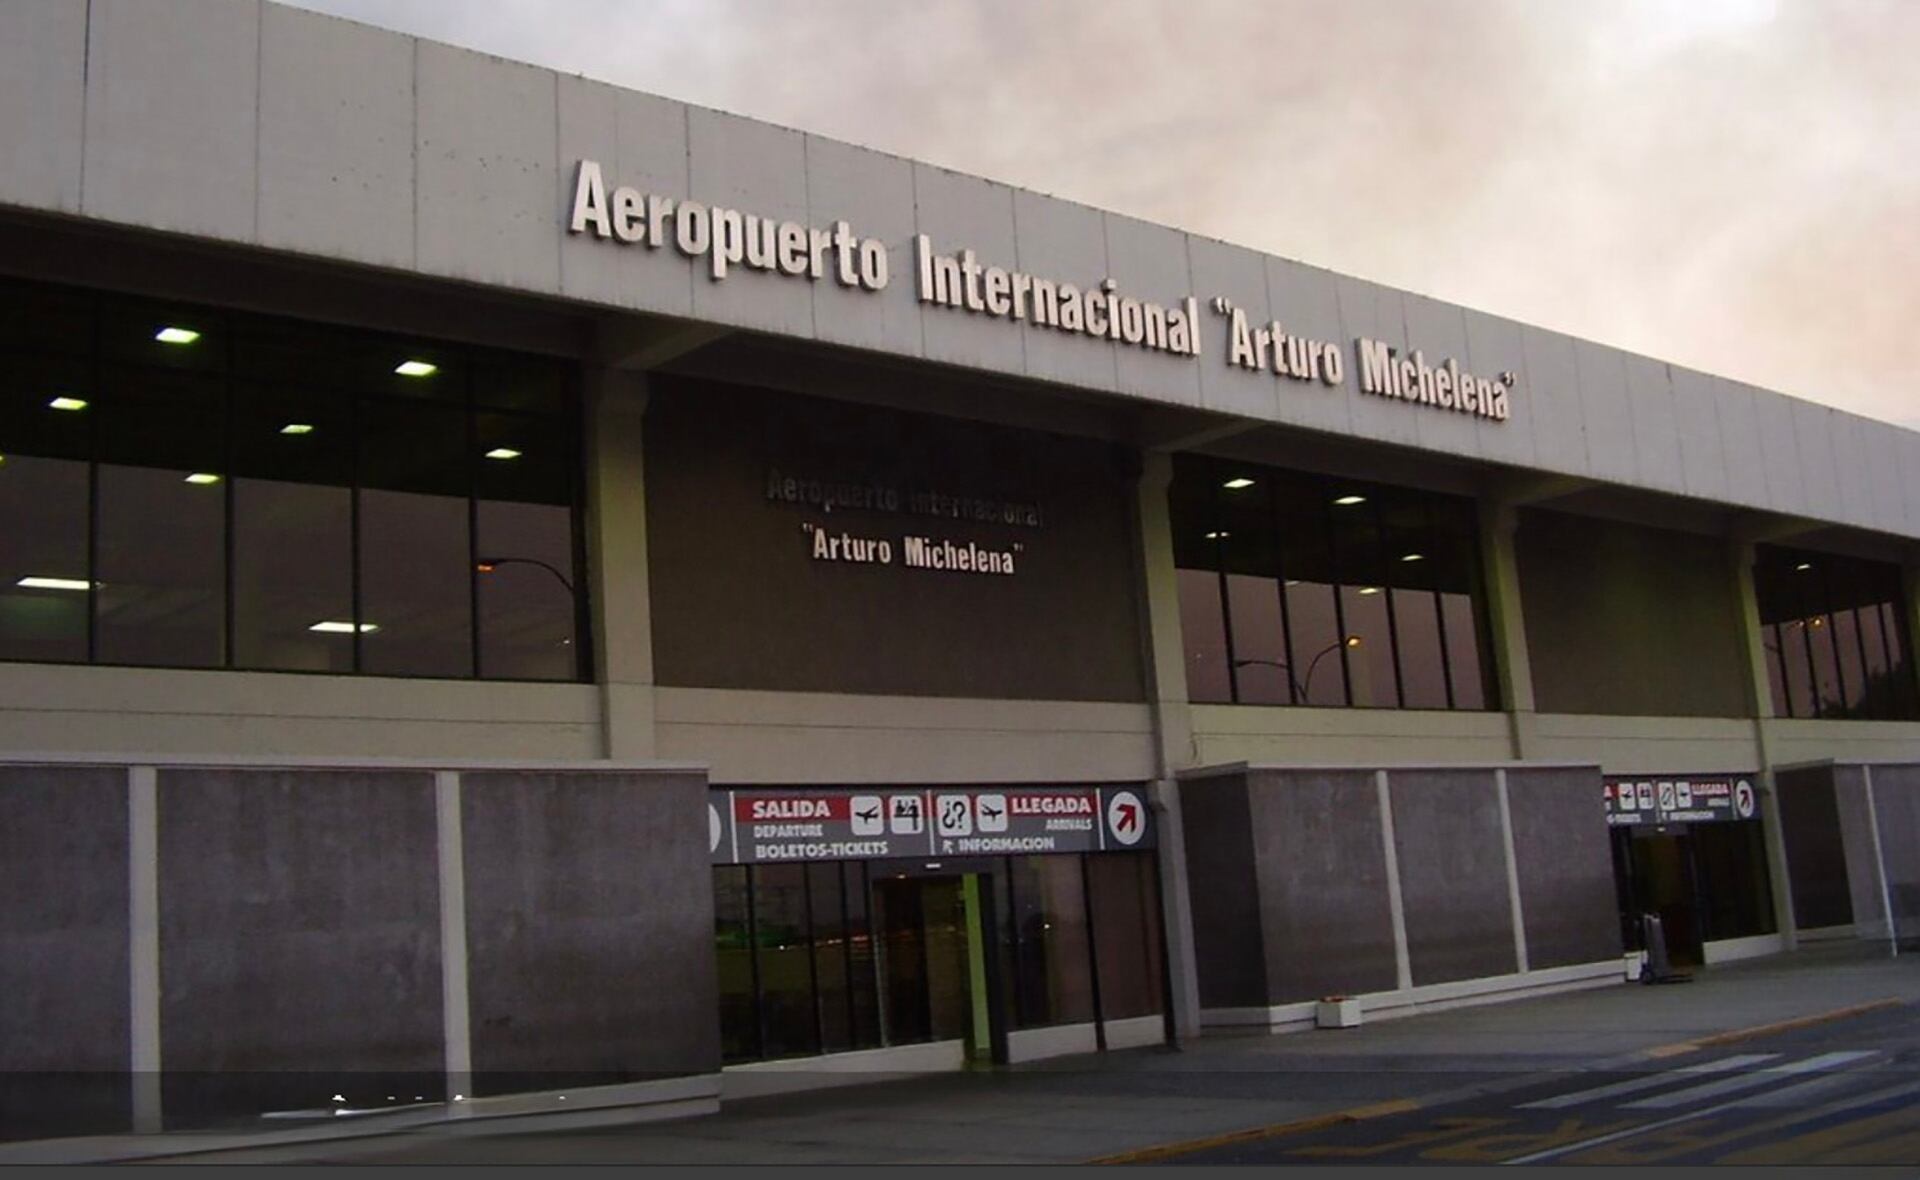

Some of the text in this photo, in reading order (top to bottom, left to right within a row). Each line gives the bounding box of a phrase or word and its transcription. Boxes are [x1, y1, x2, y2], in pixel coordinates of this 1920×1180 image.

[568, 159, 888, 290] Aeropuerto
[915, 234, 1200, 356] Internacional
[767, 468, 897, 513] Aeropuerto
[802, 523, 1024, 574] "Arturo Michelena"
[752, 800, 831, 819] SALIDA
[1012, 797, 1092, 814] LLEGADA
[753, 824, 823, 838] DEPARTURE
[755, 841, 888, 859] BOLETOS-TICKETS
[959, 837, 1055, 852] INFORMACION
